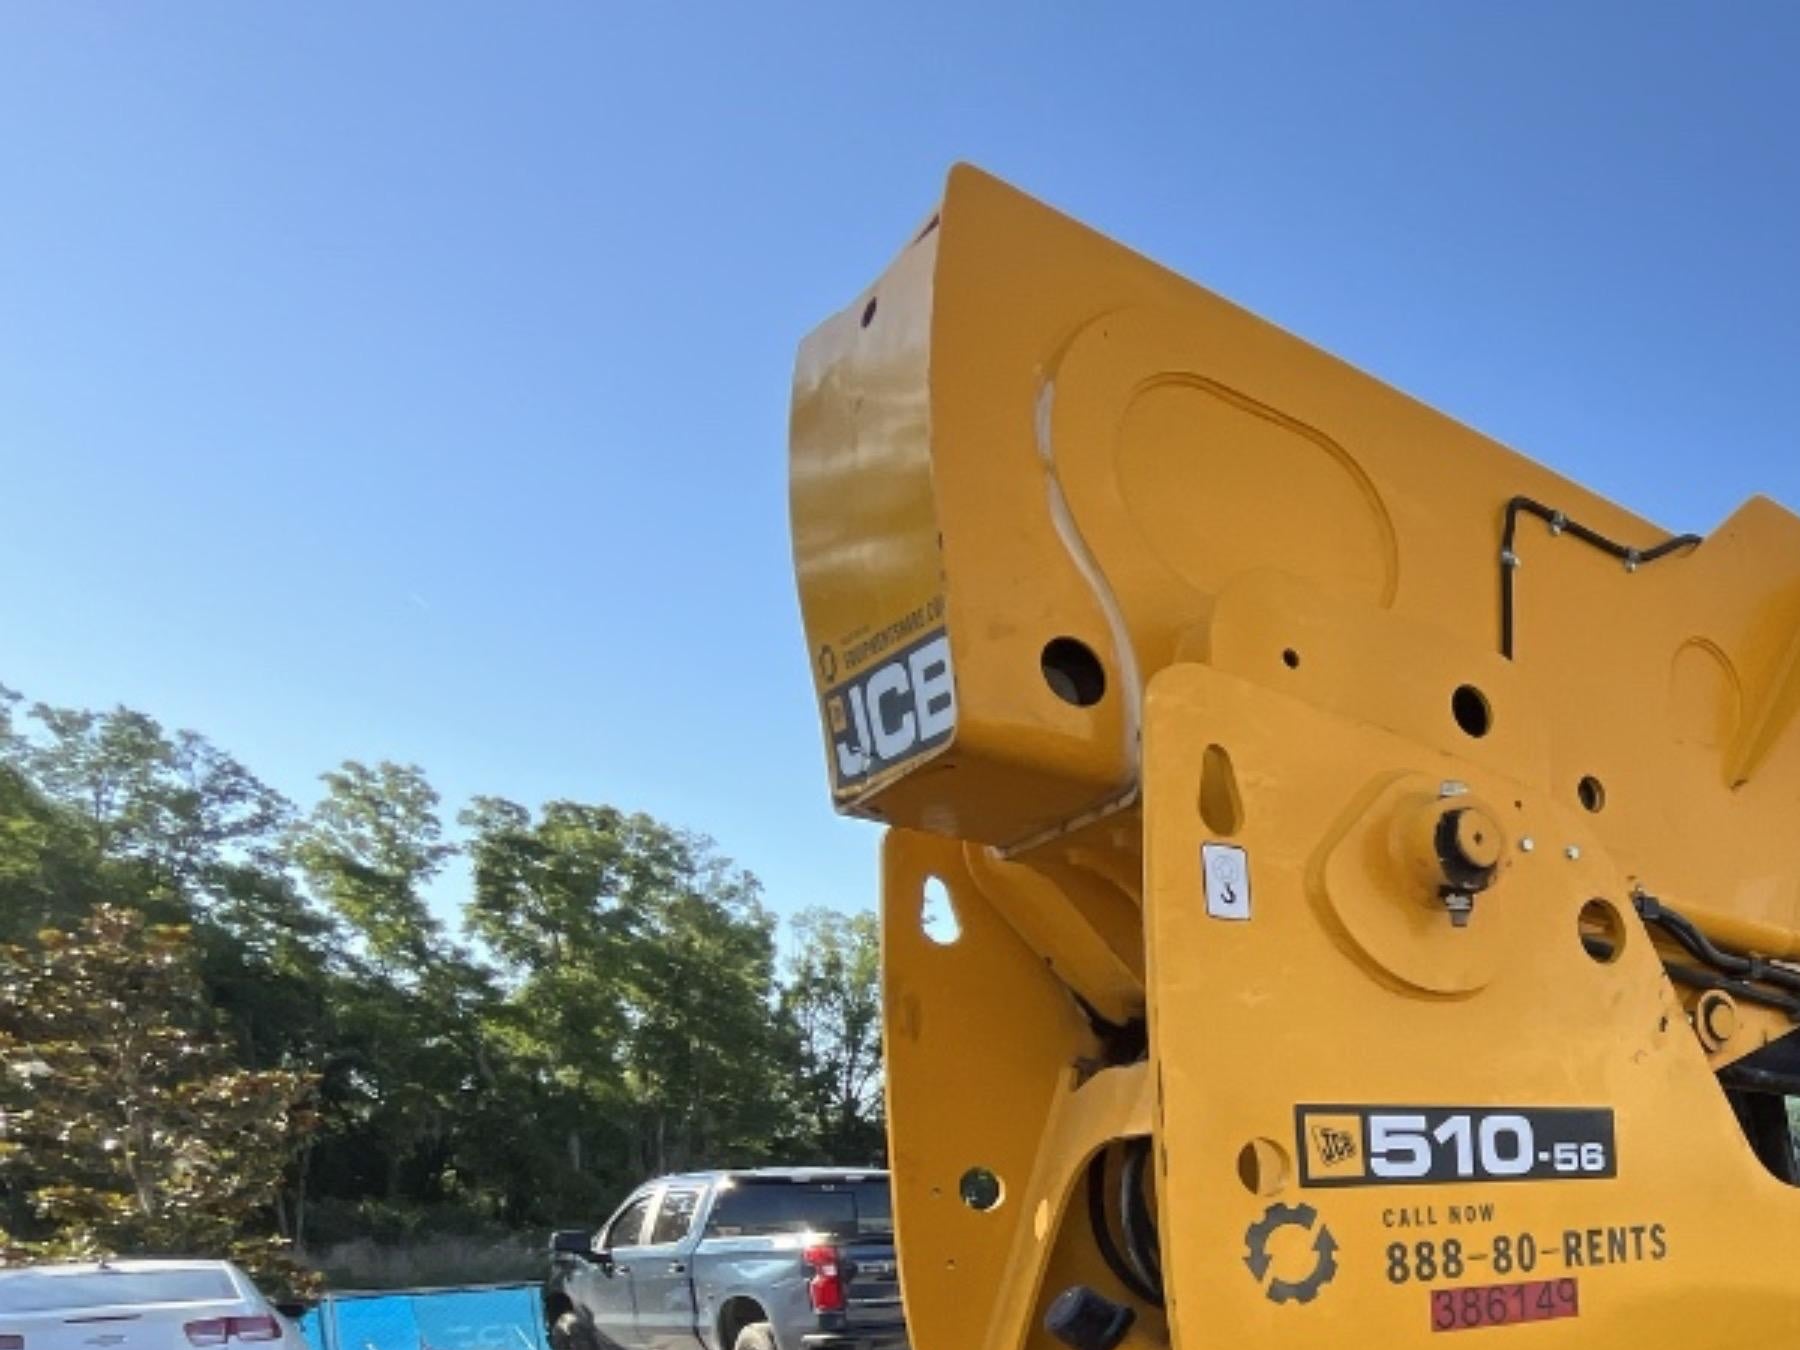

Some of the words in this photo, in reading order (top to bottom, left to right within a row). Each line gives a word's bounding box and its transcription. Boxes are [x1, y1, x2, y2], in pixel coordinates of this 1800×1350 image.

[1382, 1207, 1438, 1229] CALL
[1449, 1203, 1495, 1225] NOW
[1386, 1223, 1667, 1285] 888-80-RENTS
[1435, 1278, 1577, 1330] 386149
